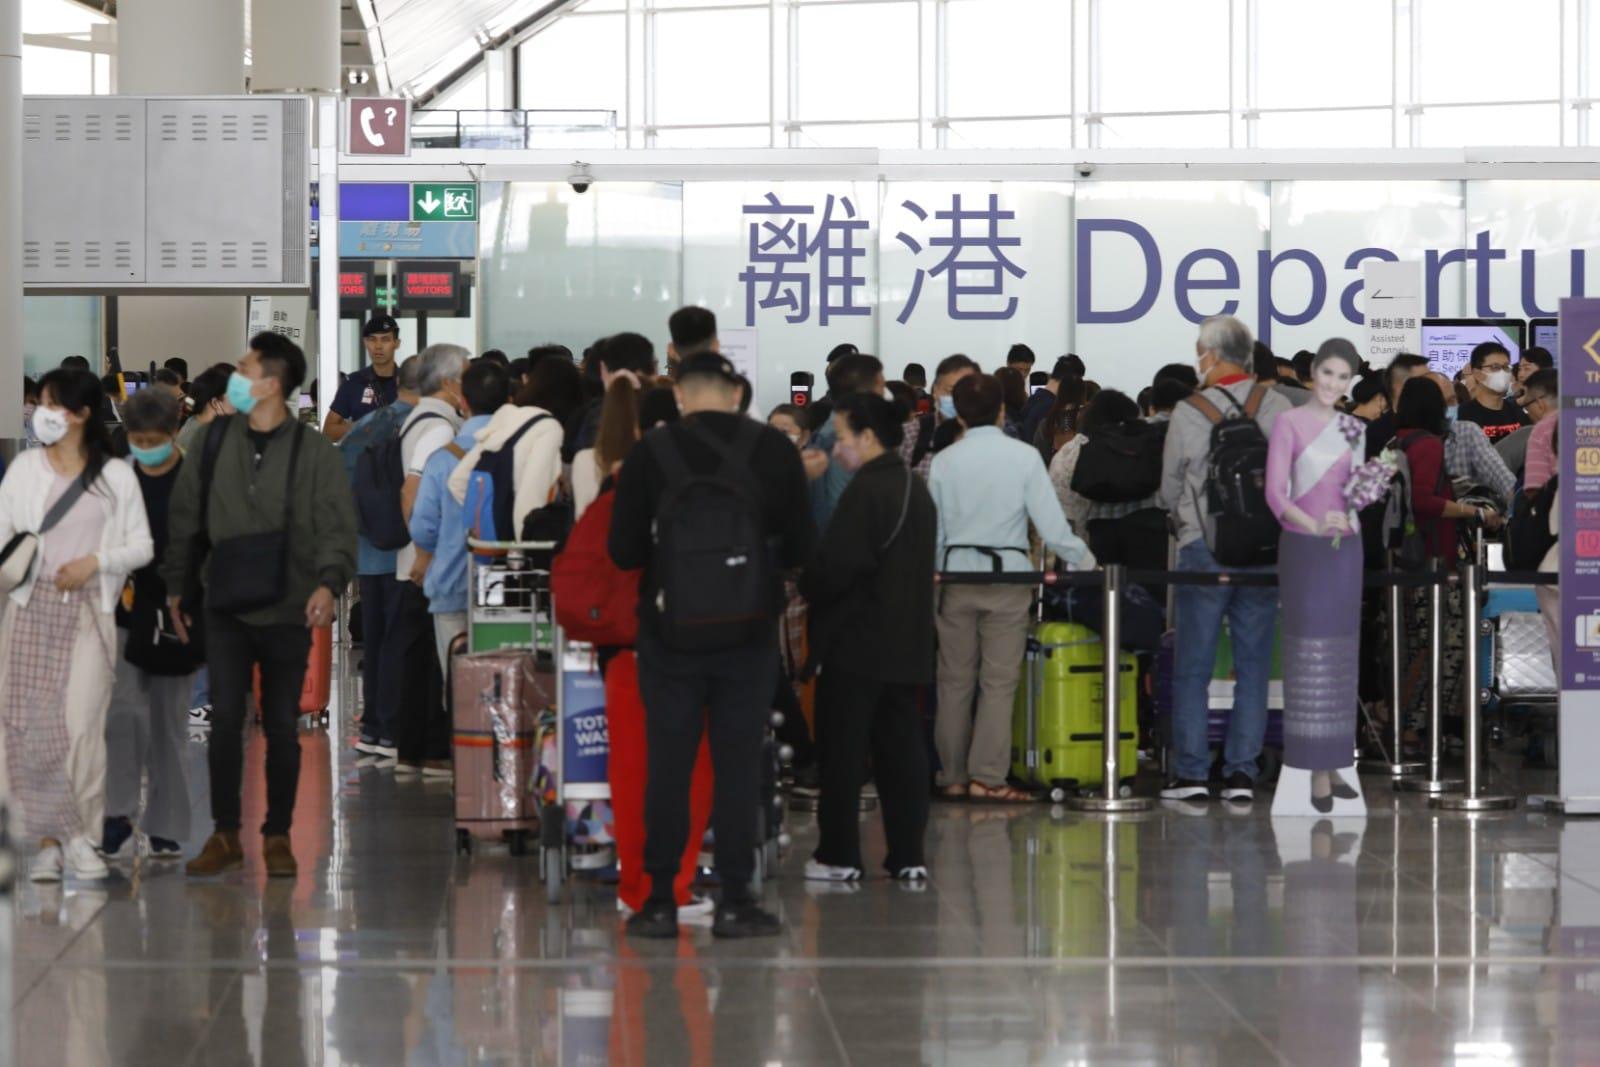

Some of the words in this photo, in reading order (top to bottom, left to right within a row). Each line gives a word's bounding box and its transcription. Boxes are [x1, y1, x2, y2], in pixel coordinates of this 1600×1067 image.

[738, 191, 1027, 327] 離港
[1370, 334, 1405, 343] Assisted
[1578, 450, 1600, 465] 40
